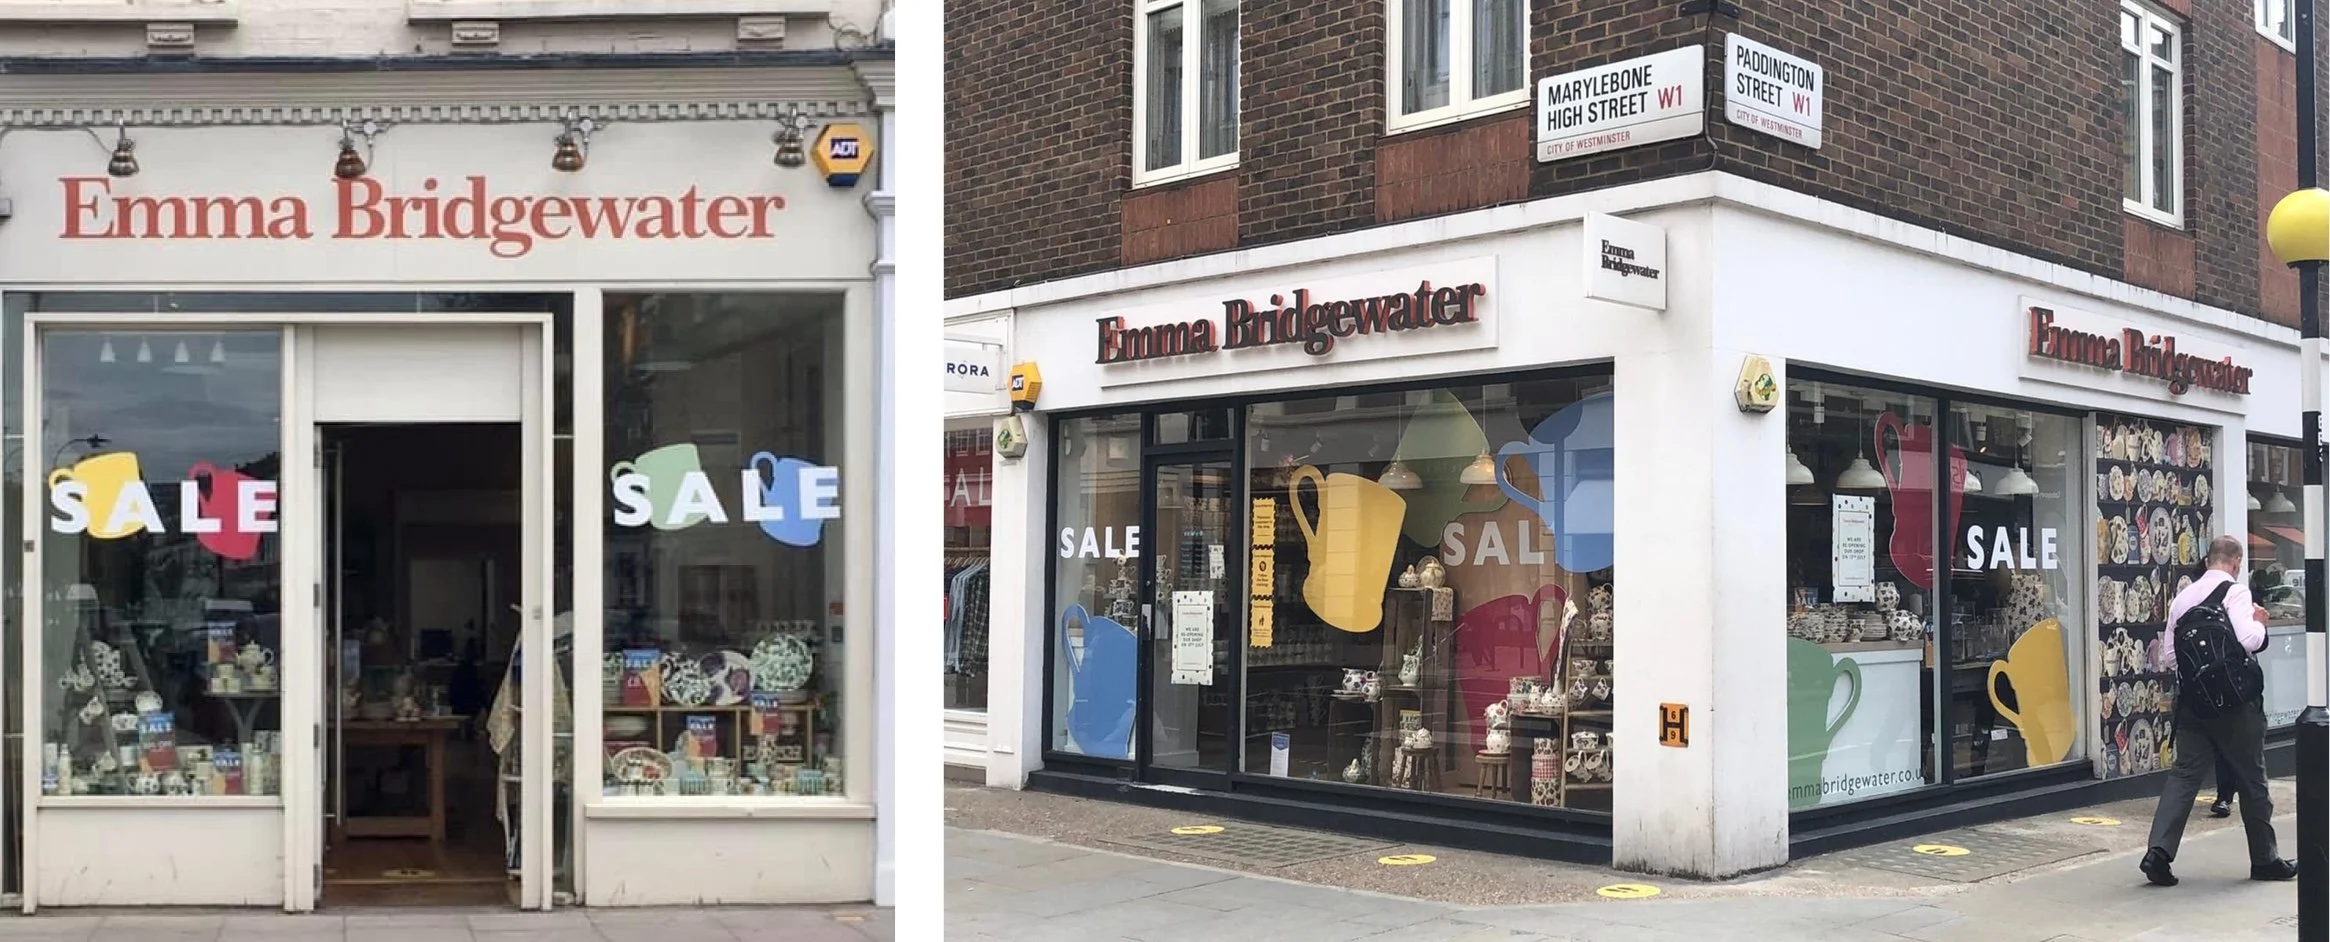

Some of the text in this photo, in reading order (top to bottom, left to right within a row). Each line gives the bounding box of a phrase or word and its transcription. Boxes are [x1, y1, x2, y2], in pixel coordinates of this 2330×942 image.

[1547, 64, 1653, 107] MARYLEBONE
[1736, 45, 1815, 92] PADDINGTON
[1547, 84, 1683, 132] HIGH STREET W1
[1736, 72, 1811, 117] STREET W1
[1547, 130, 1631, 156] CITY OF WESTMINSTER
[1736, 109, 1803, 139] CITY OF WESTMINSTER
[831, 142, 859, 156] ADT
[58, 175, 786, 259] Emma Bridgewater
[1600, 239, 1635, 260] Emma
[1600, 255, 1660, 280] Bridgewater
[1095, 280, 1487, 366] Emma Bridgewater
[2028, 305, 2253, 397] Emma Bridgewater
[50, 479, 278, 534] SALE
[613, 465, 841, 528] SALE
[1060, 525, 1140, 559] SALE
[1443, 518, 1545, 567] SAL
[1965, 524, 2059, 571] SALE
[1670, 730, 1676, 740] 9
[1671, 710, 1677, 720] 6
